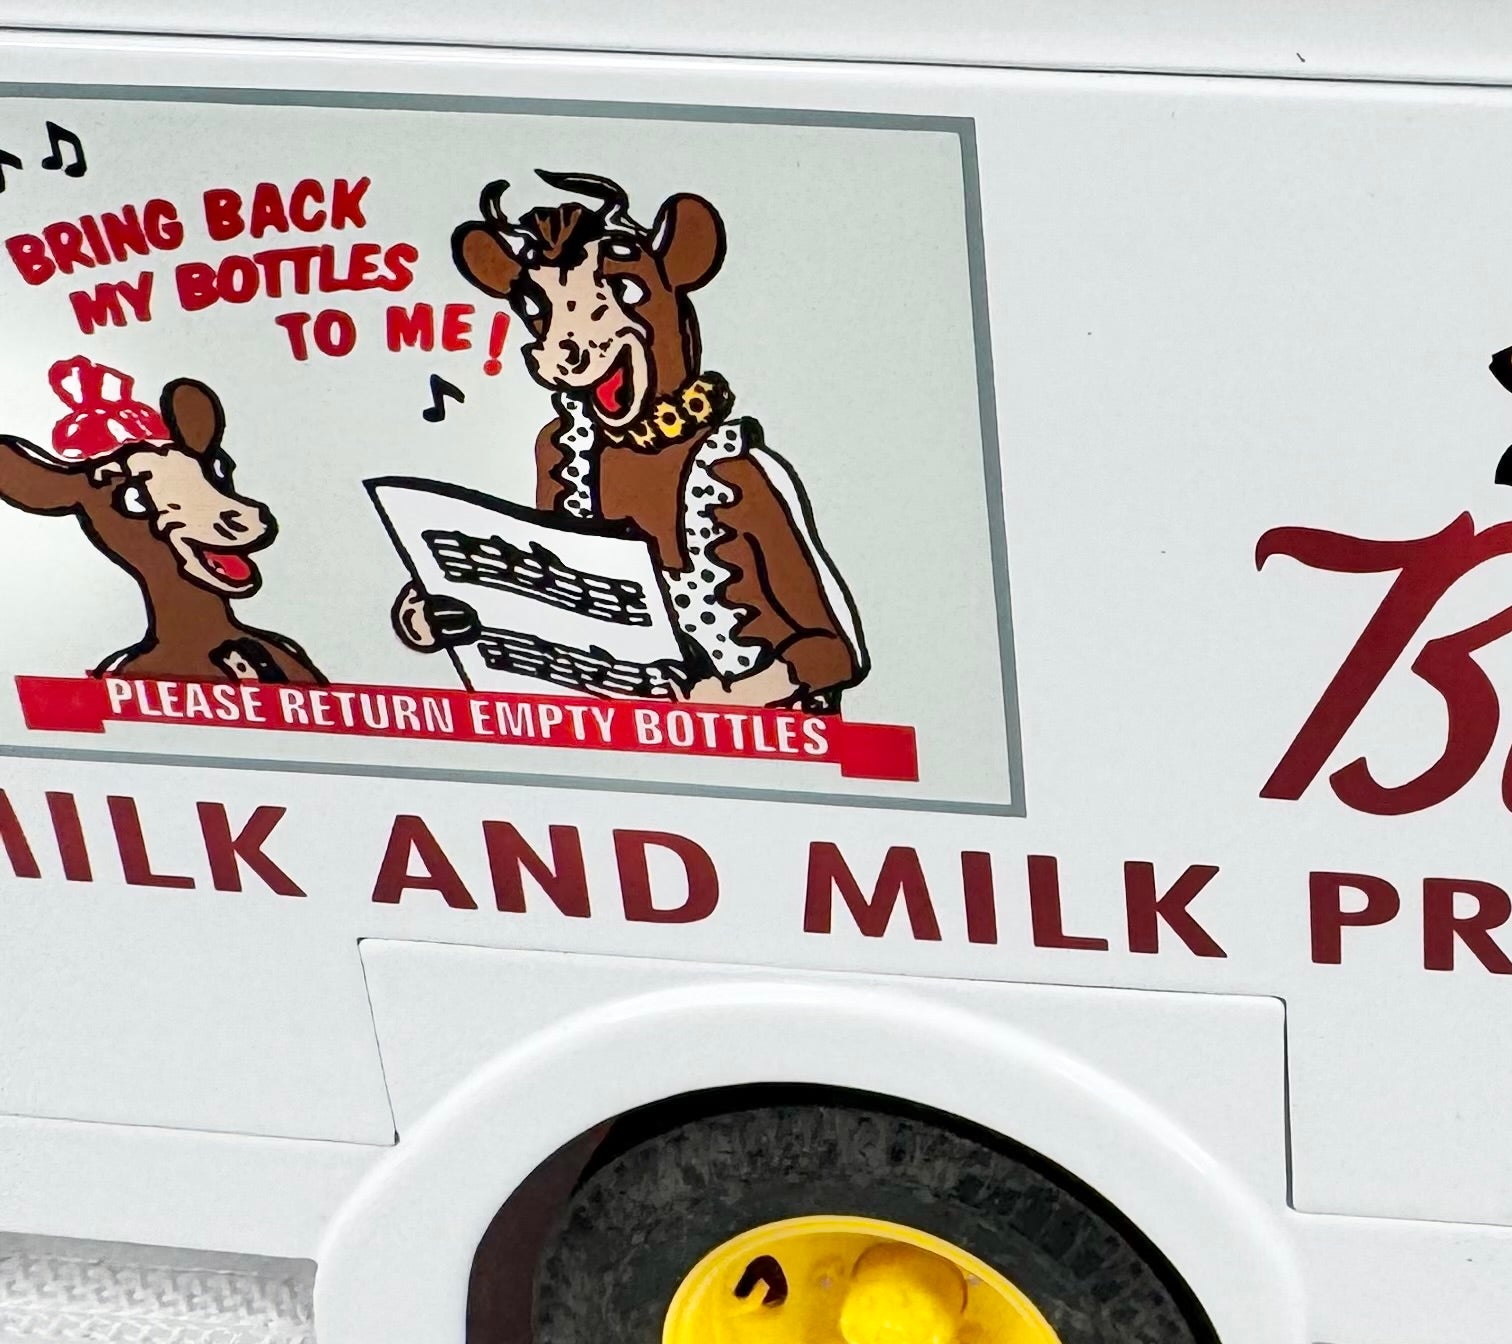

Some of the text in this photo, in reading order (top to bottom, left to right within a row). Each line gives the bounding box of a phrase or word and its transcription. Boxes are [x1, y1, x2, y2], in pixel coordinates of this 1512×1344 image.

[5, 176, 371, 288] BRING BACK
[69, 242, 419, 336] MY BOTTLES
[276, 310, 356, 361] TO
[105, 677, 830, 756] PLEASE RETURN EMPTY BOTTLES
[371, 813, 722, 926] AND
[803, 840, 1229, 960] MILK
